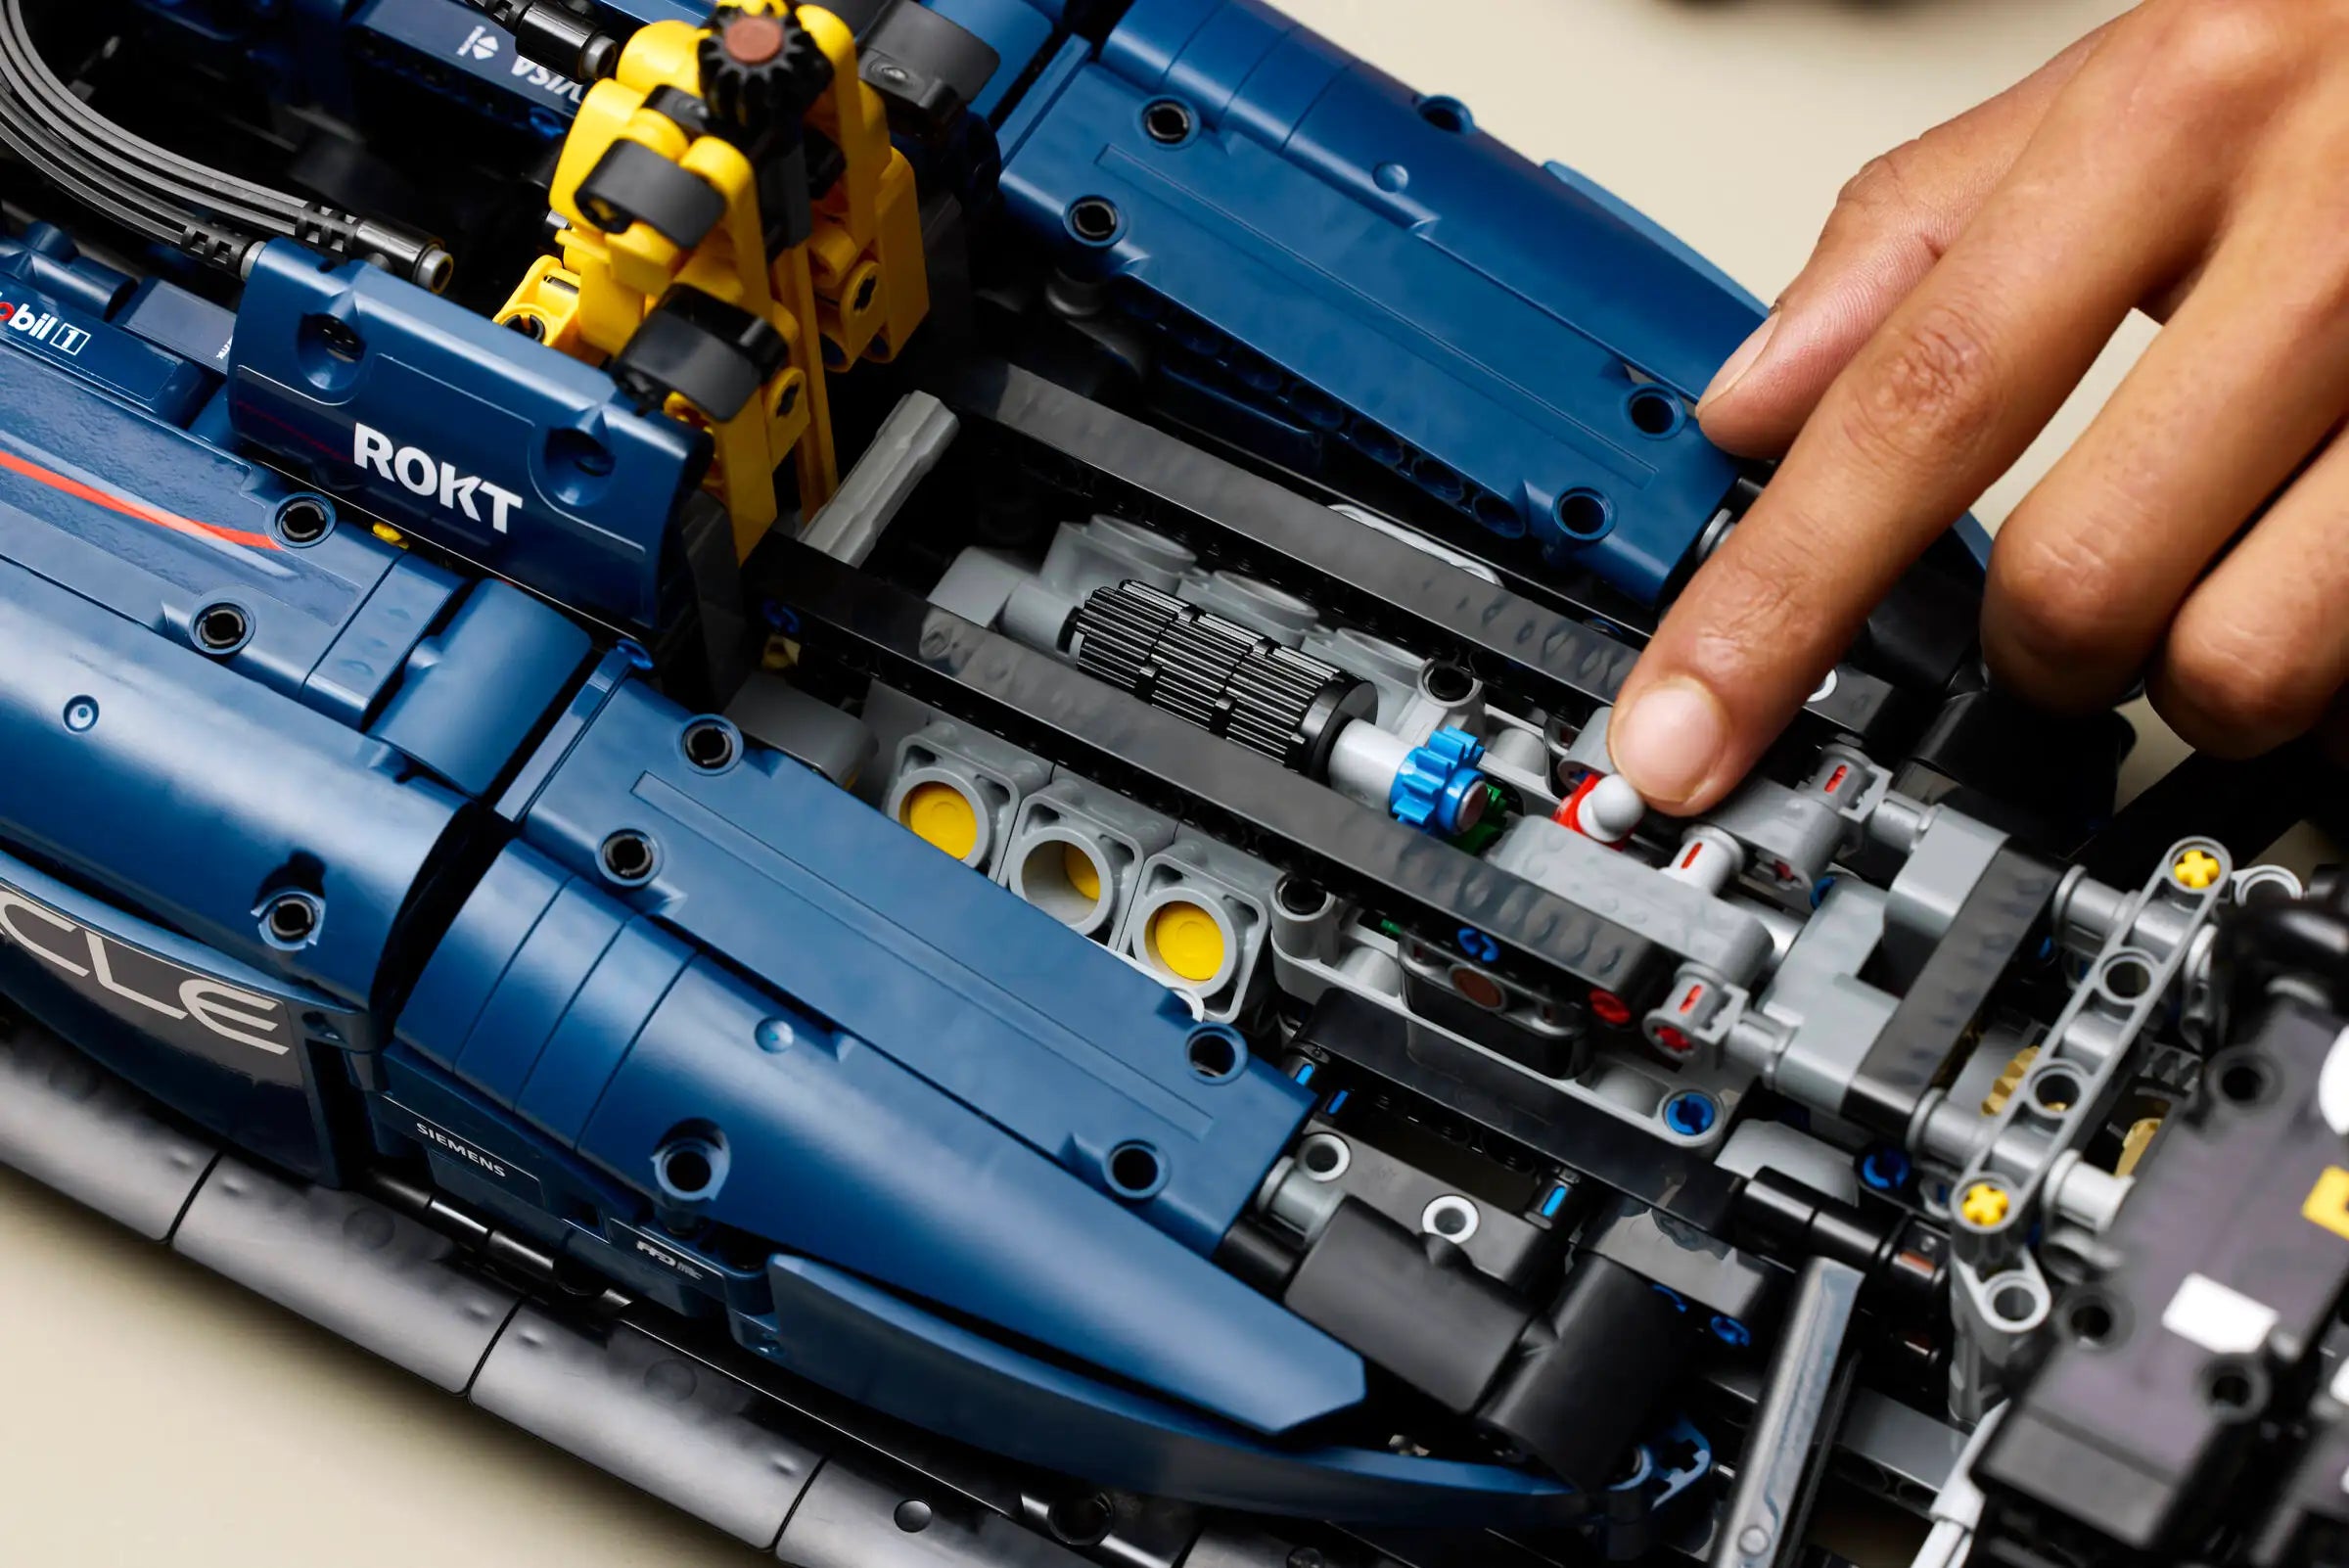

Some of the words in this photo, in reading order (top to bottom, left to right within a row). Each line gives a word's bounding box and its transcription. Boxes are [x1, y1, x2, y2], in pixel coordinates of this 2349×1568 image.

[511, 55, 583, 104] VISA
[0, 292, 59, 341] obil
[353, 422, 524, 534] ROKT
[0, 890, 291, 1055] CLE
[416, 1122, 507, 1177] SIEMENS
